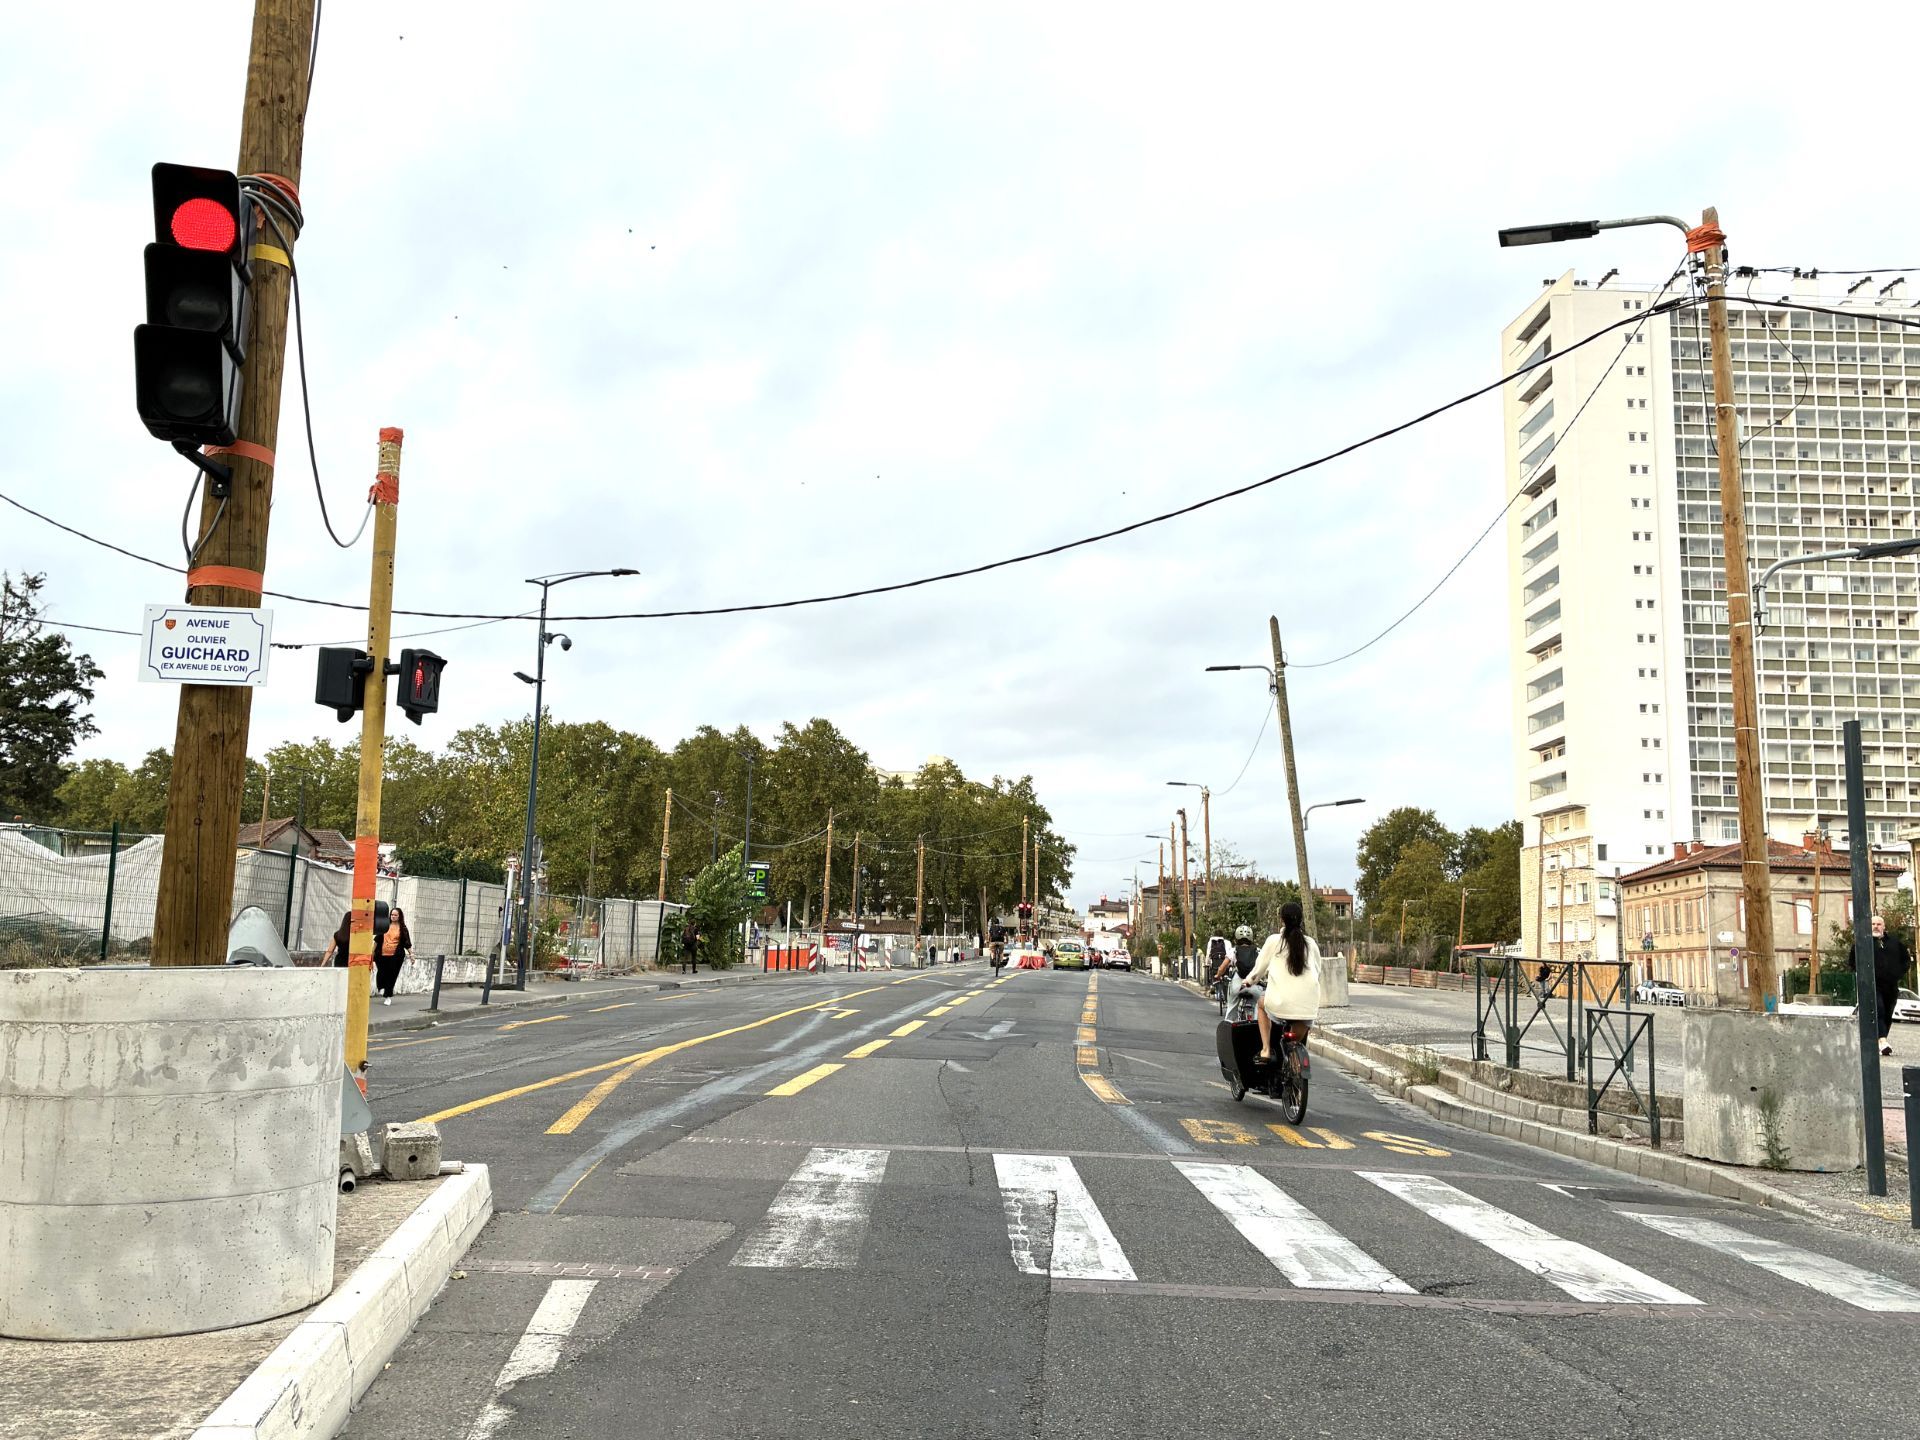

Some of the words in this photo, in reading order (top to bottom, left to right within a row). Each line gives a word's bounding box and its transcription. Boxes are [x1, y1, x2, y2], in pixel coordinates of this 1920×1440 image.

[186, 619, 231, 629] AVENUE
[187, 635, 227, 645] OLIVIER
[161, 646, 250, 662] GUICHARD
[160, 662, 174, 670] (EX
[176, 663, 209, 671] AVENUE
[223, 664, 248, 673] LYON)
[756, 870, 765, 882] P
[1177, 1118, 1452, 1157] BUS
